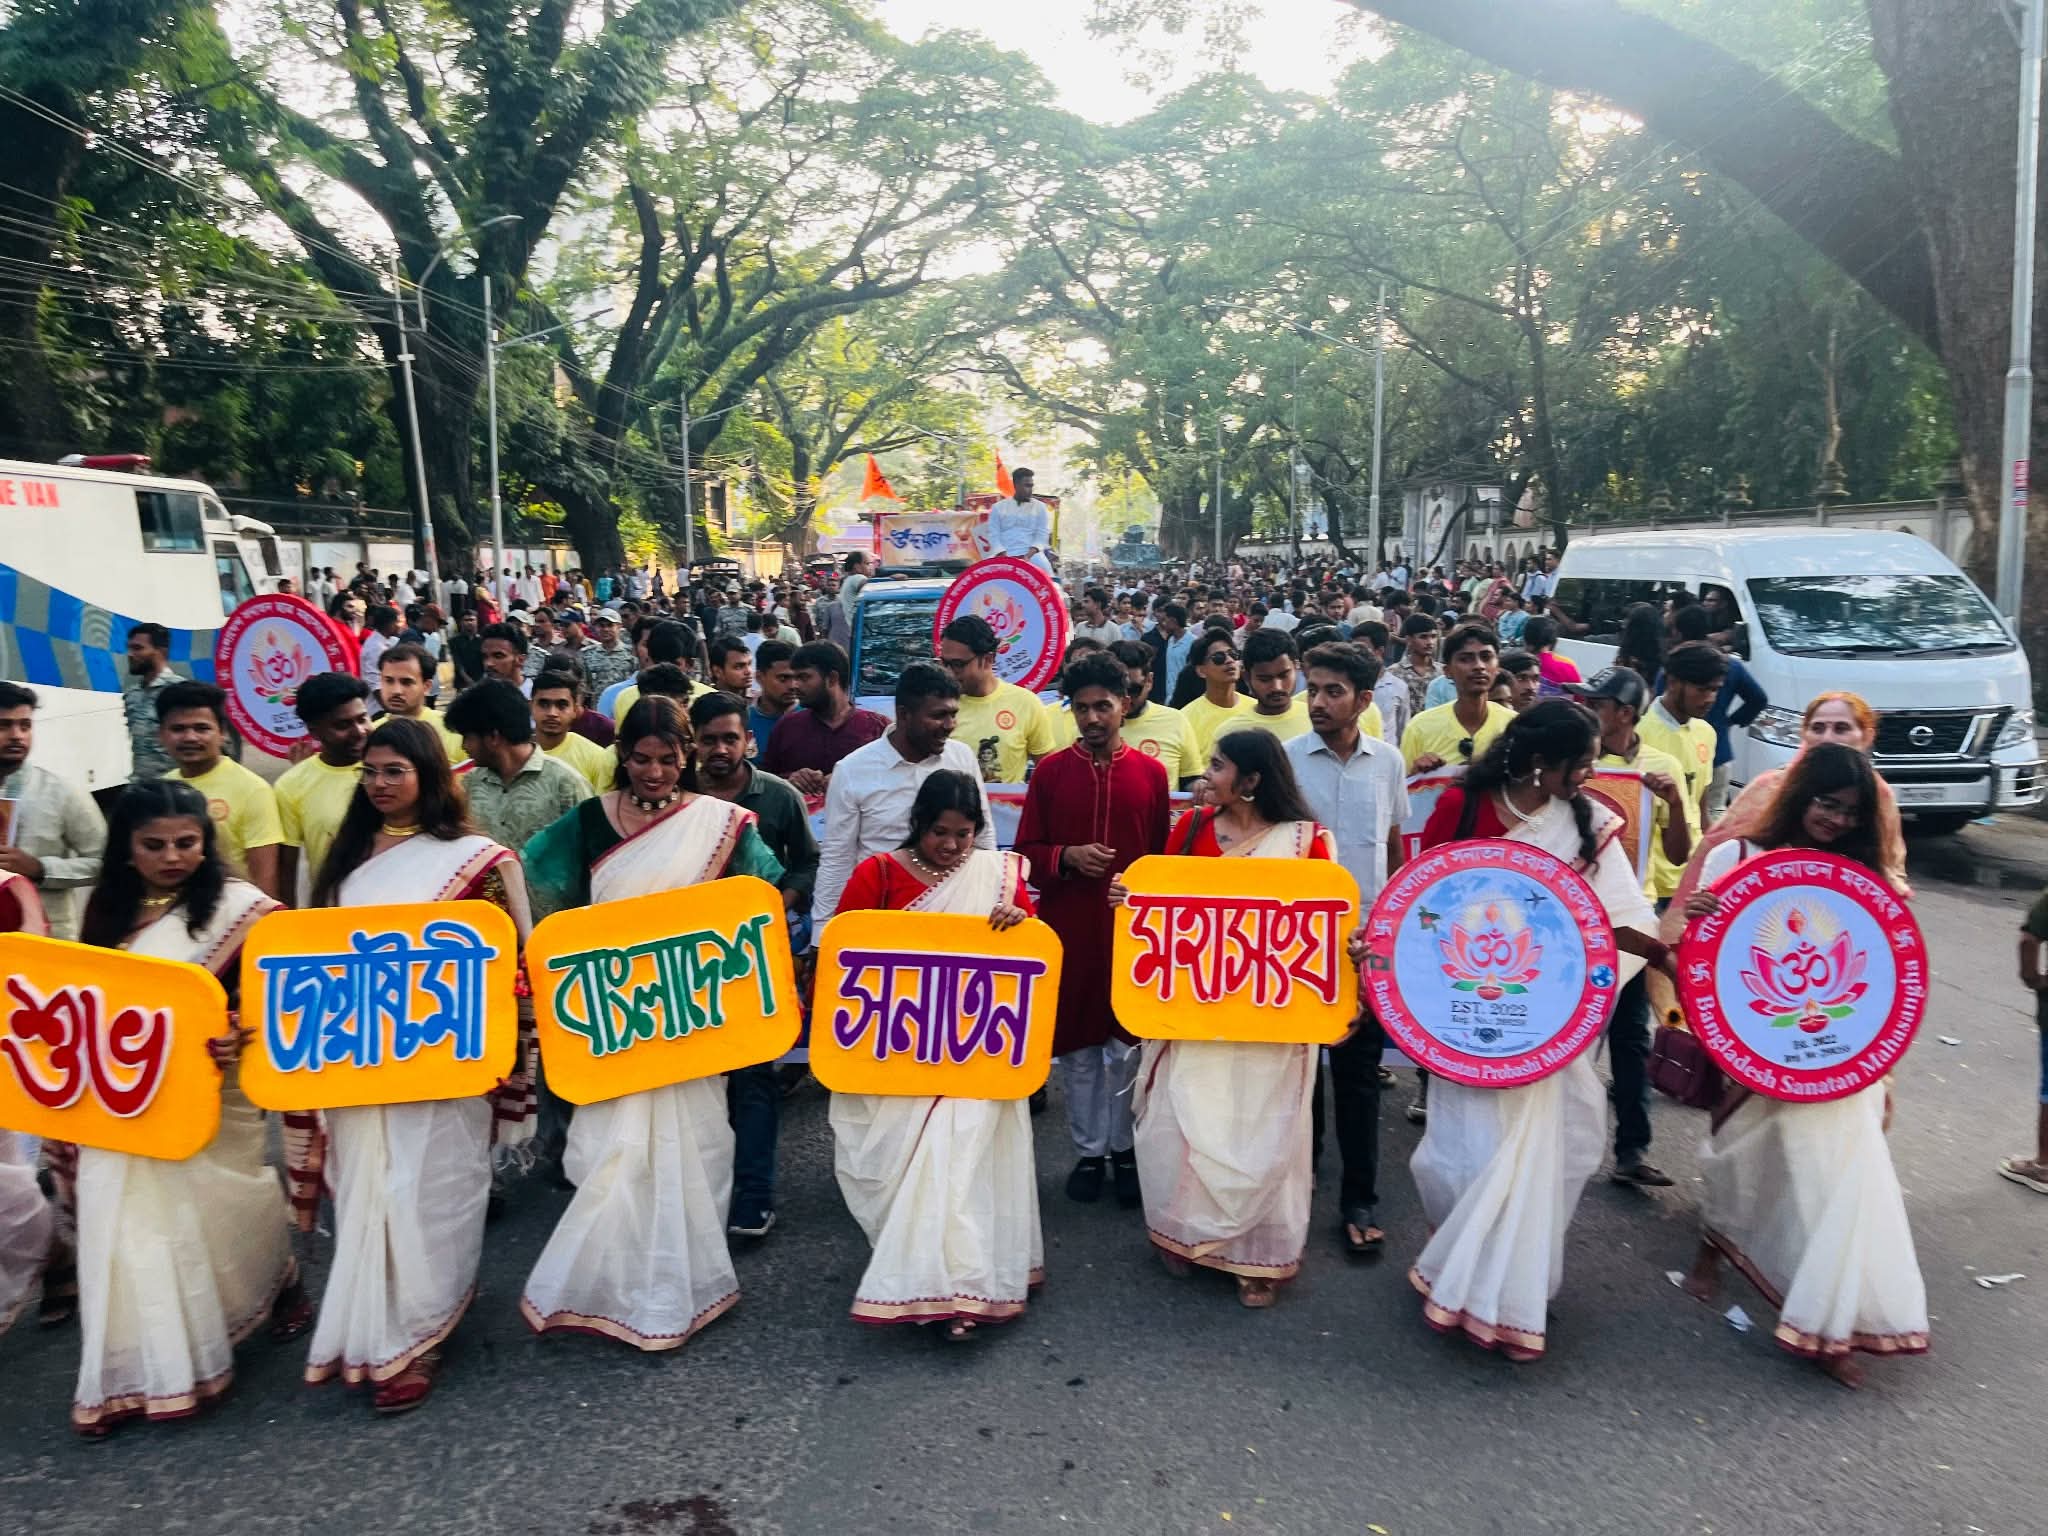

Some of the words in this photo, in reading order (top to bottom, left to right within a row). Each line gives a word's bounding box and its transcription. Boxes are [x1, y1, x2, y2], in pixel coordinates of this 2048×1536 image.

[21, 481, 60, 508] VAN
[1765, 860, 1836, 880] সনাতন
[1840, 866, 1905, 921] মহাসংঘ
[547, 913, 777, 1058] বাংলাদেশ
[833, 948, 1047, 1067] সনাতন
[1127, 894, 1352, 1008] মহাসংঘ
[0, 975, 172, 1117] শুভ
[1373, 979, 1426, 1056] Bangladesh
[1427, 1048, 1481, 1079] Sanatan
[1543, 993, 1609, 1069] Mahasangha
[1695, 996, 1778, 1089] Bangladesh
[1779, 1071, 1862, 1097] Sanatan
[1857, 959, 1927, 1078] Mahasangha
